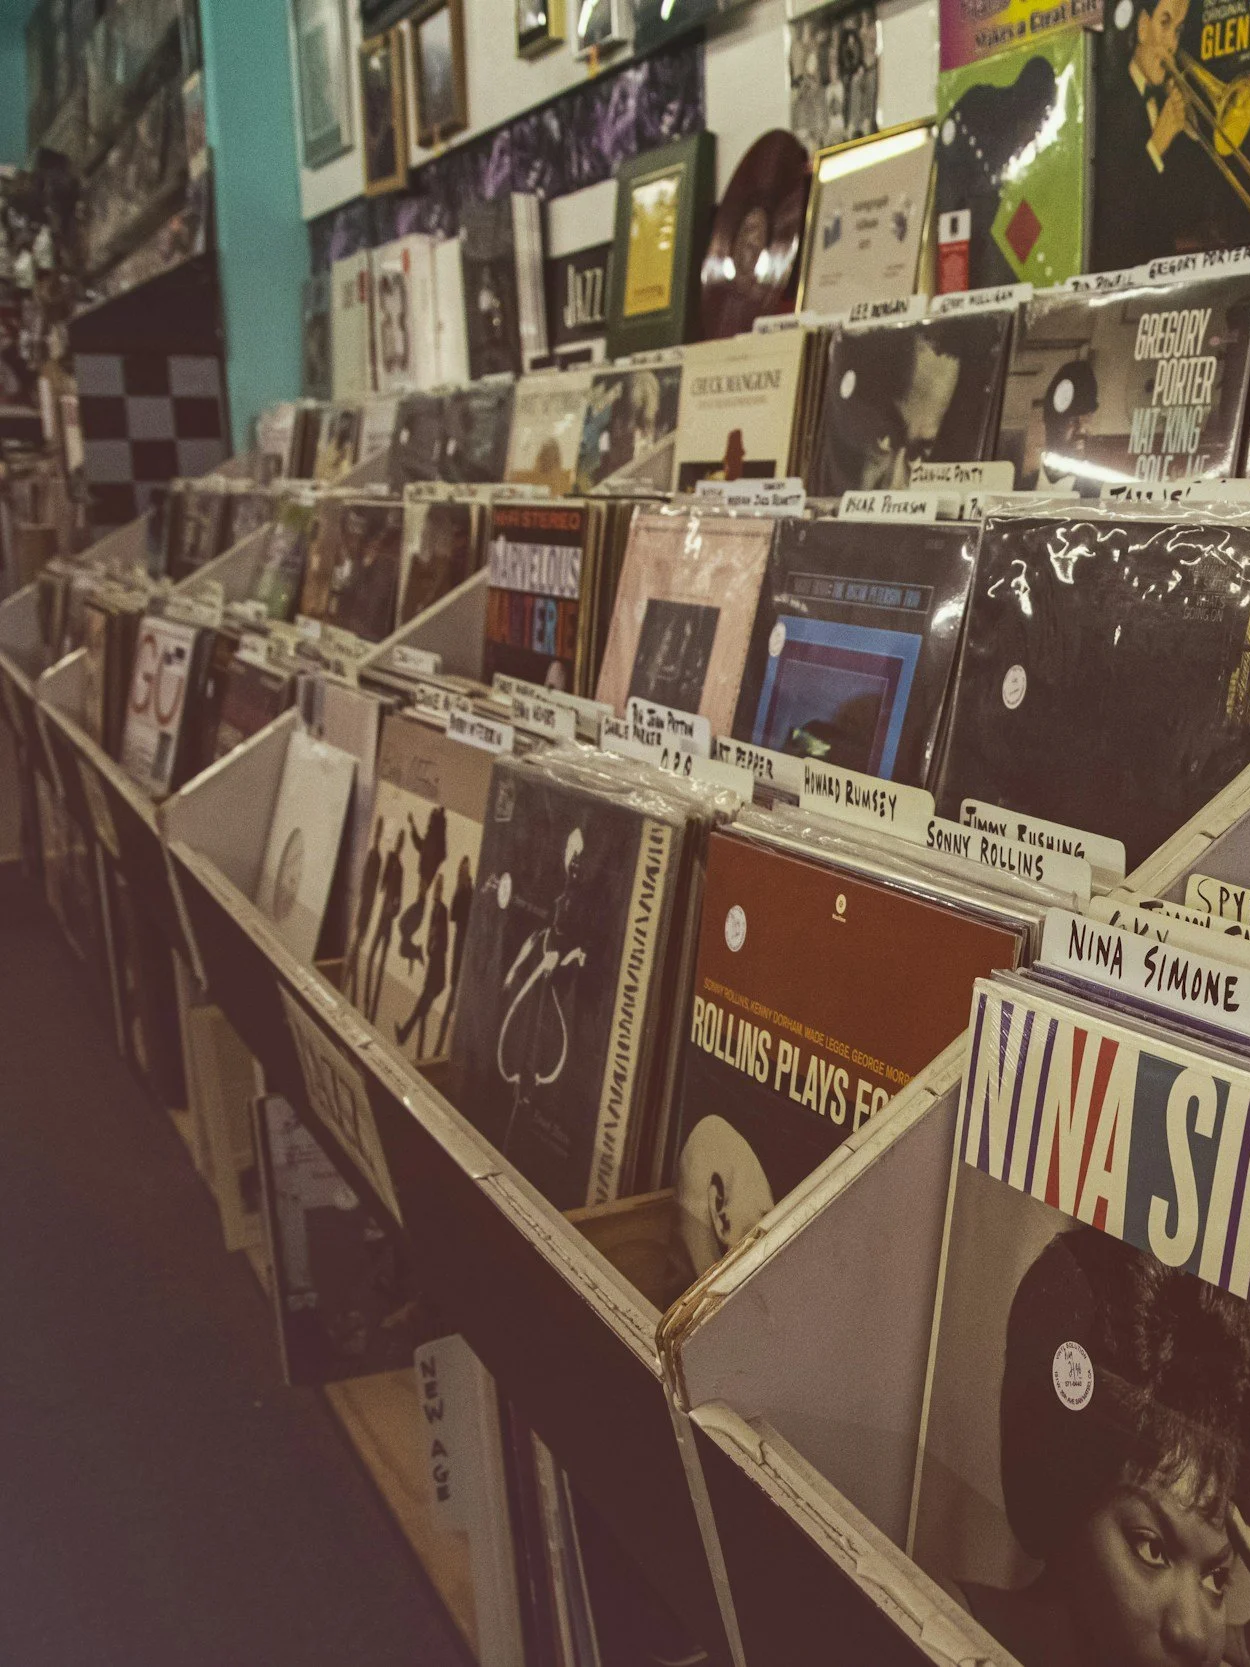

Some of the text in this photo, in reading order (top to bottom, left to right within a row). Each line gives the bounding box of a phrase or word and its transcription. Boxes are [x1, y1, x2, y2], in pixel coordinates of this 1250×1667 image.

[1149, 256, 1197, 281] GREGORY
[1134, 308, 1212, 361] GREGORY
[1152, 355, 1218, 406] PORTER
[1127, 408, 1161, 454] NAT
[881, 496, 927, 514] PETERSON
[735, 744, 774, 780] PEPPER
[804, 765, 898, 822] HOWARD RUMSEY
[926, 820, 1044, 881] SONNY ROLLINS
[1017, 823, 1086, 860] RUSHING
[1068, 919, 1123, 979] NINA
[1144, 945, 1240, 1012] SIMONE
[691, 995, 772, 1084] ROLLINS
[774, 1039, 849, 1126] PLAYS
[804, 1025, 825, 1047] WADE
[851, 1048, 885, 1076] GEORGE
[964, 993, 1136, 1240] NINA
[419, 1355, 450, 1502] NEW AGE
